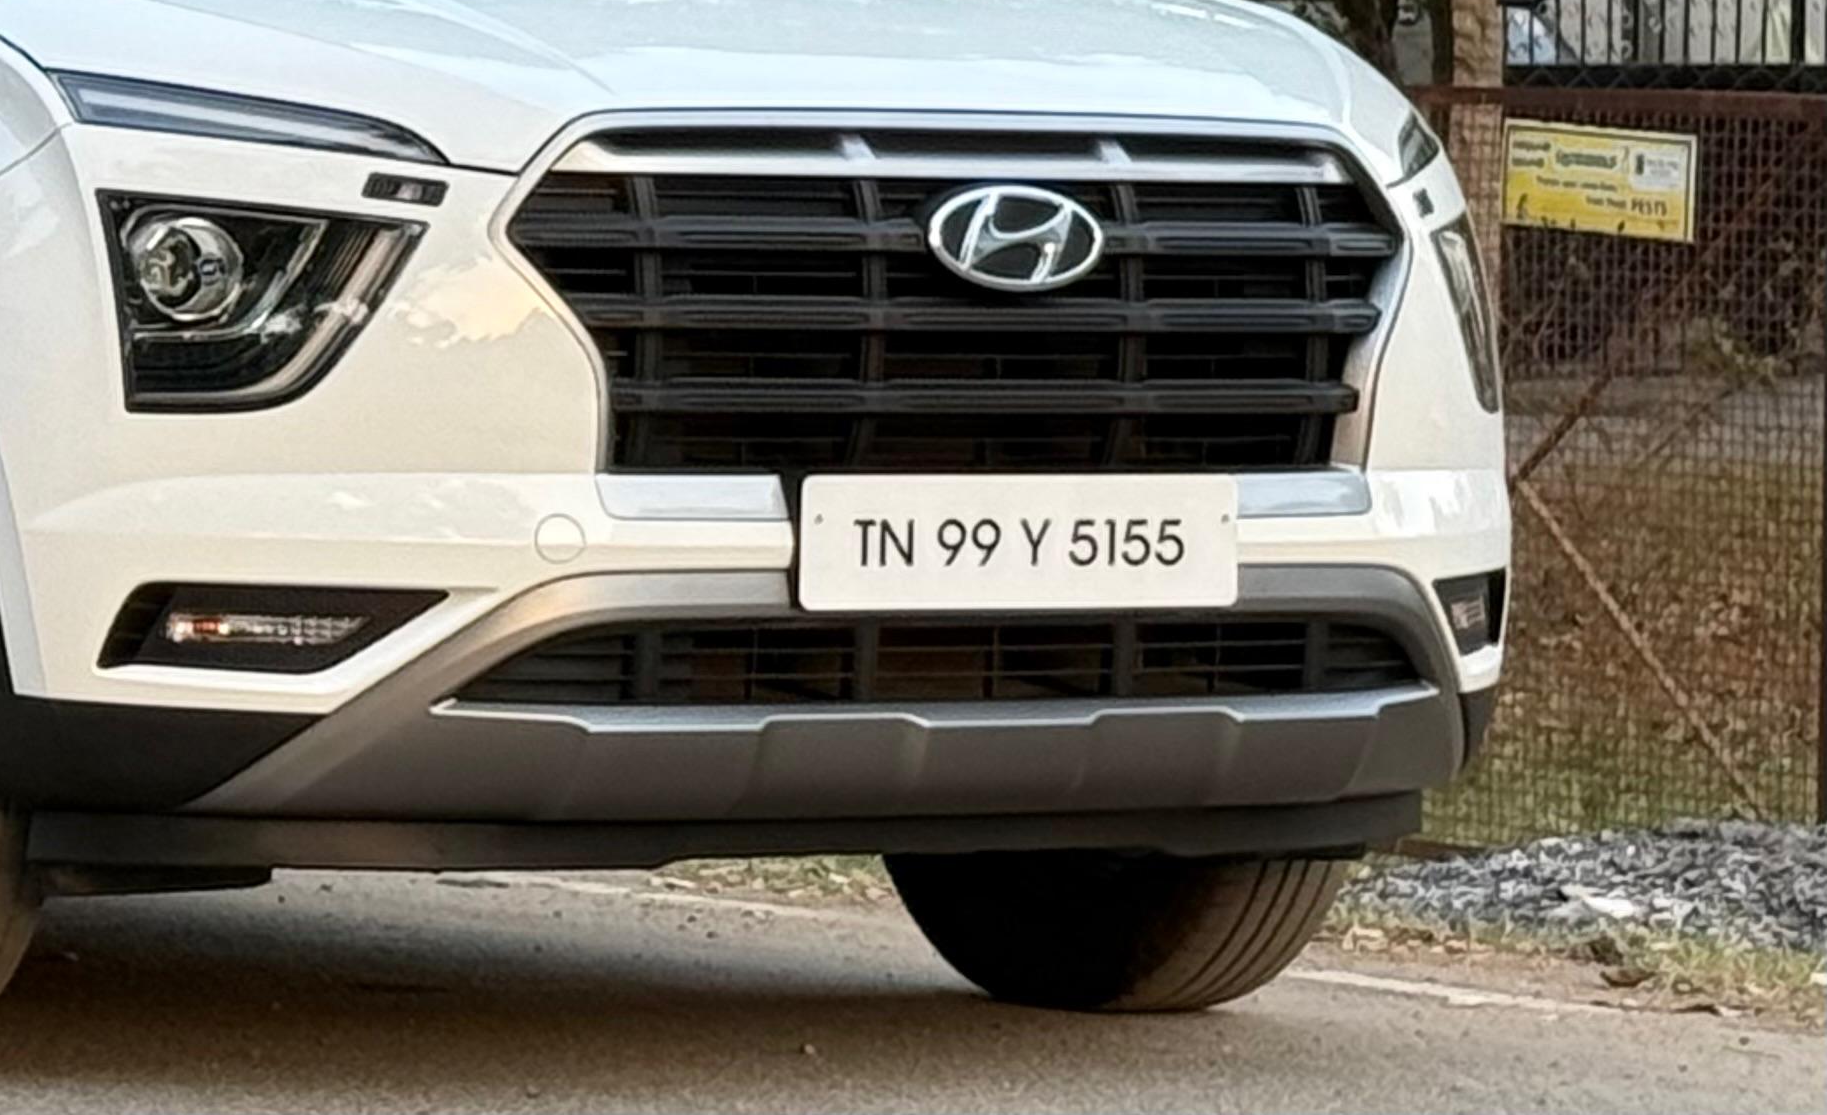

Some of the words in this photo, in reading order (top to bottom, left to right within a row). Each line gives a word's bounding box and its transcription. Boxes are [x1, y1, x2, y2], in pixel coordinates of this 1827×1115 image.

[853, 518, 914, 567] TN
[936, 517, 1002, 566] 99
[1020, 518, 1051, 566] Y
[1068, 517, 1185, 567] 5155
